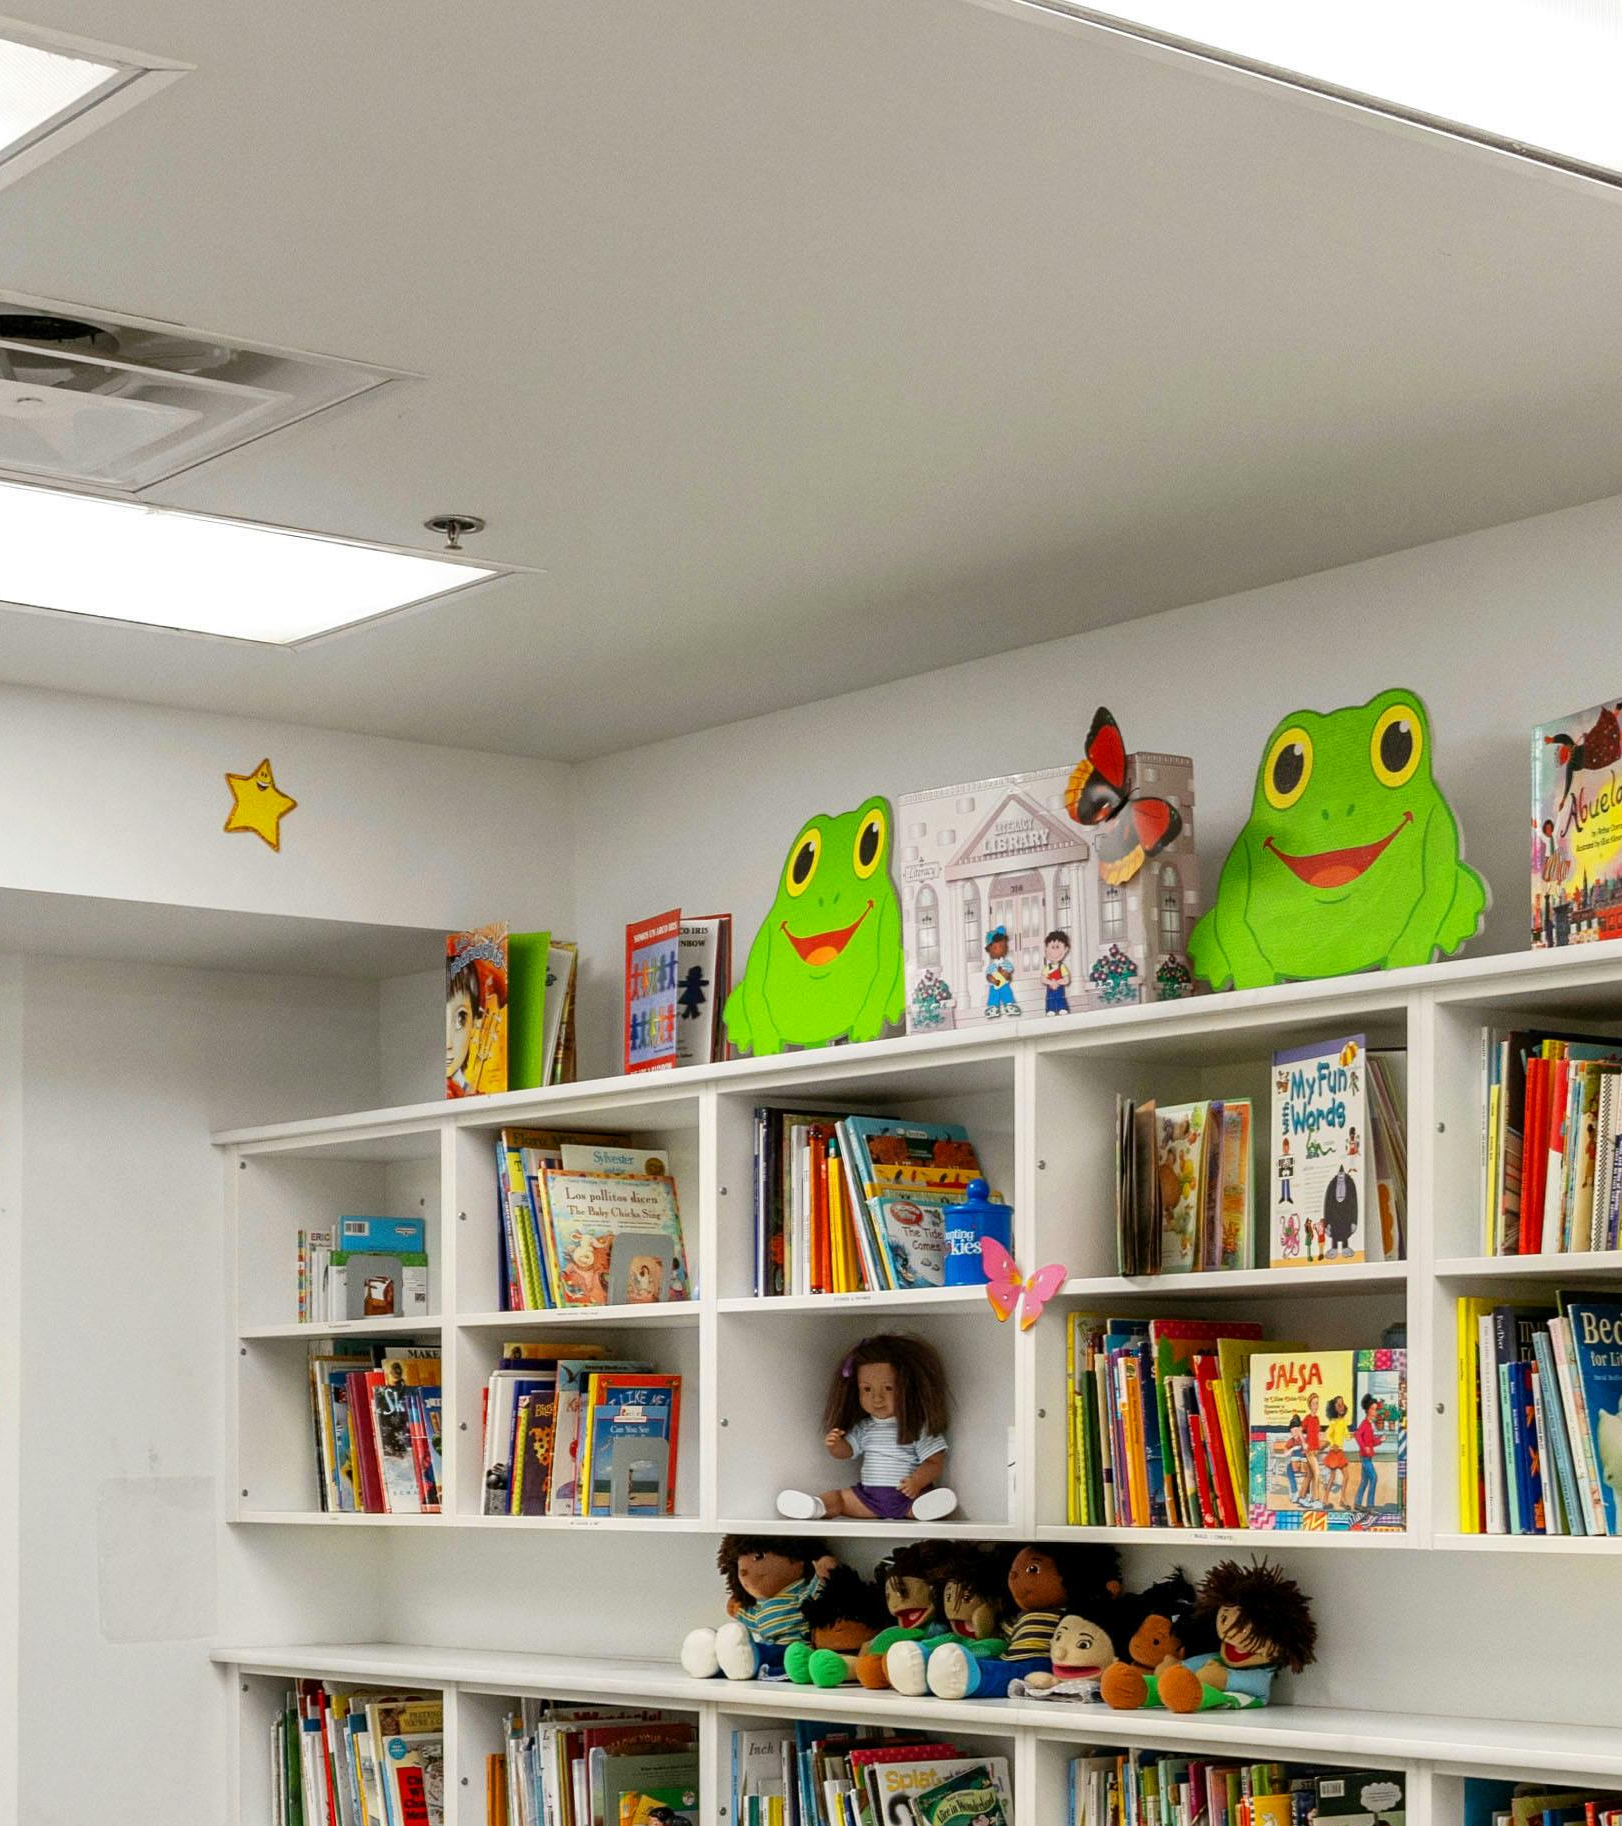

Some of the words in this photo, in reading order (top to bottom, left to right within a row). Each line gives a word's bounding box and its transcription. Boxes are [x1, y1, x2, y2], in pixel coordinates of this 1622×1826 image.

[984, 829, 1050, 856] LIBRARY
[691, 926, 709, 935] IRIS
[1289, 1069, 1317, 1101] My
[1316, 1061, 1348, 1097] Fun
[1281, 1101, 1291, 1135] with
[1290, 1098, 1346, 1136] Words
[593, 1151, 634, 1166] Sylvester
[565, 1186, 586, 1200] Los
[589, 1190, 628, 1203] pollitos
[630, 1191, 658, 1204] dicen
[567, 1204, 585, 1216] The
[588, 1205, 609, 1218] Baby
[611, 1206, 640, 1218] Chicks
[641, 1207, 661, 1220] Sing
[903, 1226, 919, 1238] The
[922, 1226, 944, 1239] Tide
[1496, 1314, 1504, 1350] Fox/Dyer
[407, 1349, 440, 1360] MAKE
[1590, 1350, 1608, 1367] for
[1264, 1361, 1323, 1393] SALSA
[619, 1390, 648, 1405] LIKE
[748, 1743, 775, 1756] Inch
